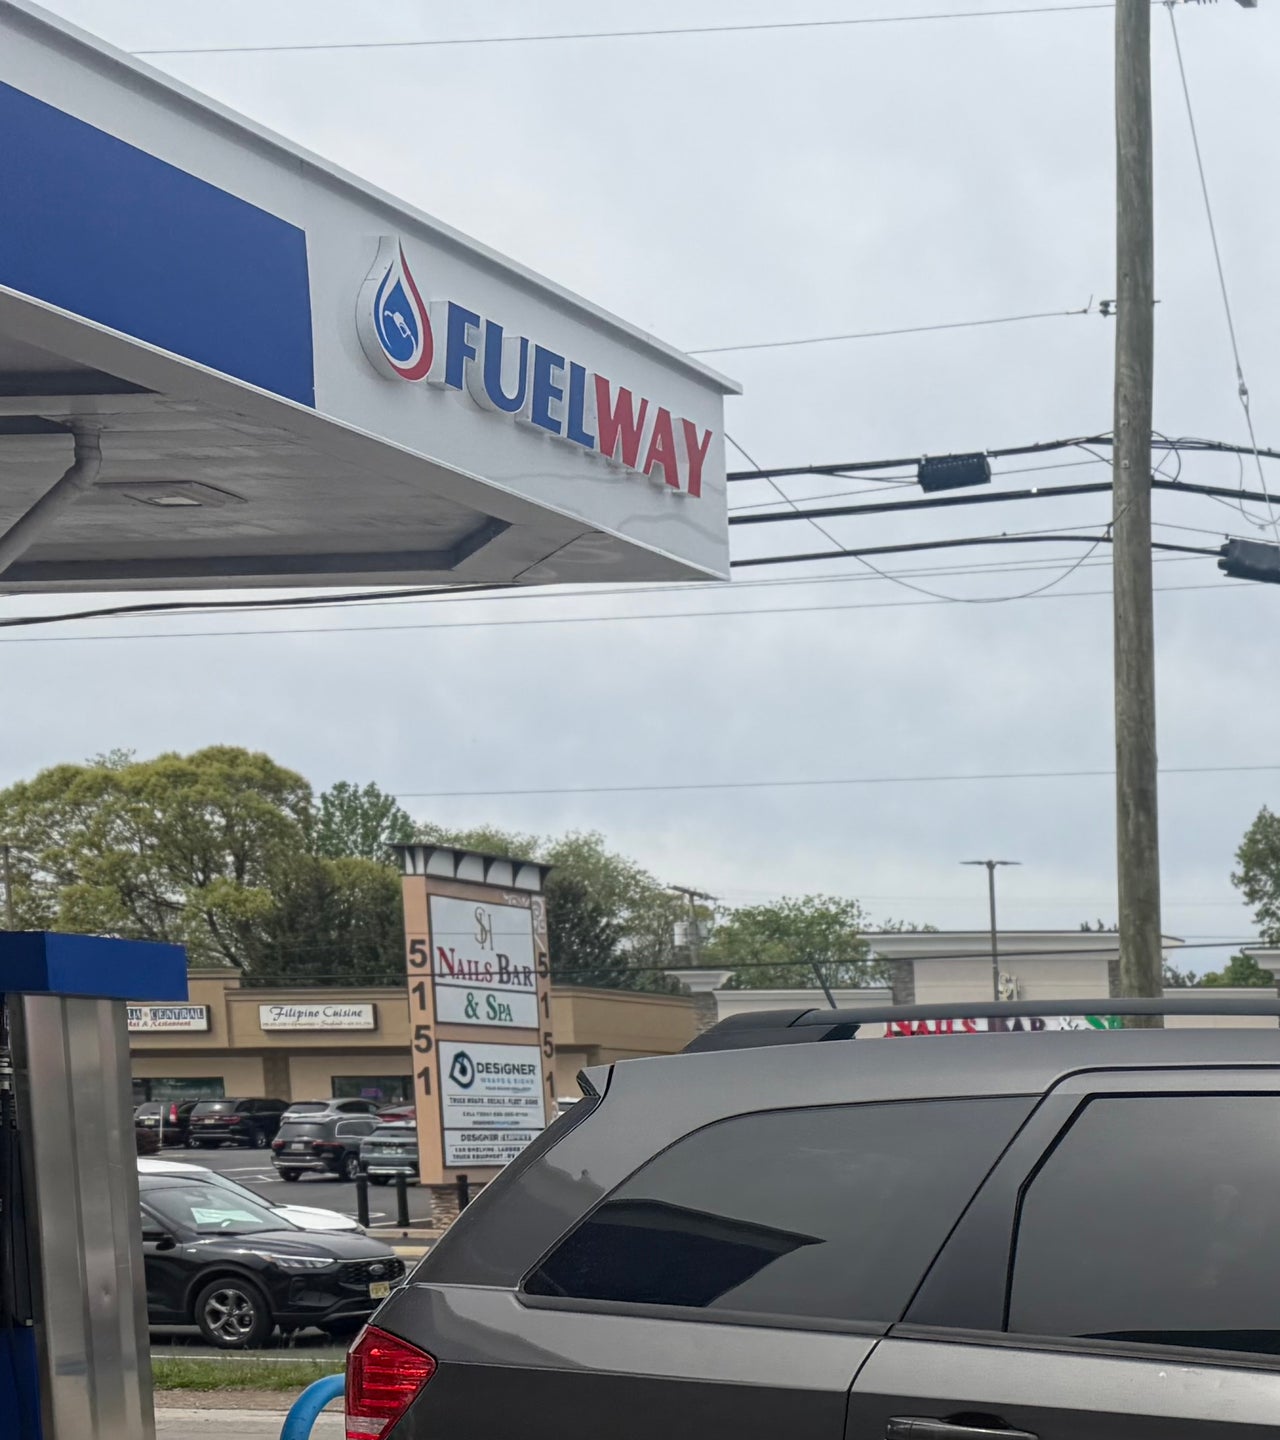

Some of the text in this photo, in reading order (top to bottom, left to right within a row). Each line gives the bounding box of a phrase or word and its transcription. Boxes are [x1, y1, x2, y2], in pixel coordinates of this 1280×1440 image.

[444, 300, 713, 498] FUELWAY
[436, 946, 534, 987] NAILS BAR
[150, 1008, 204, 1020] CENTRAL
[269, 1006, 362, 1021] Filipino Cuisine
[464, 991, 513, 1022] & SPA
